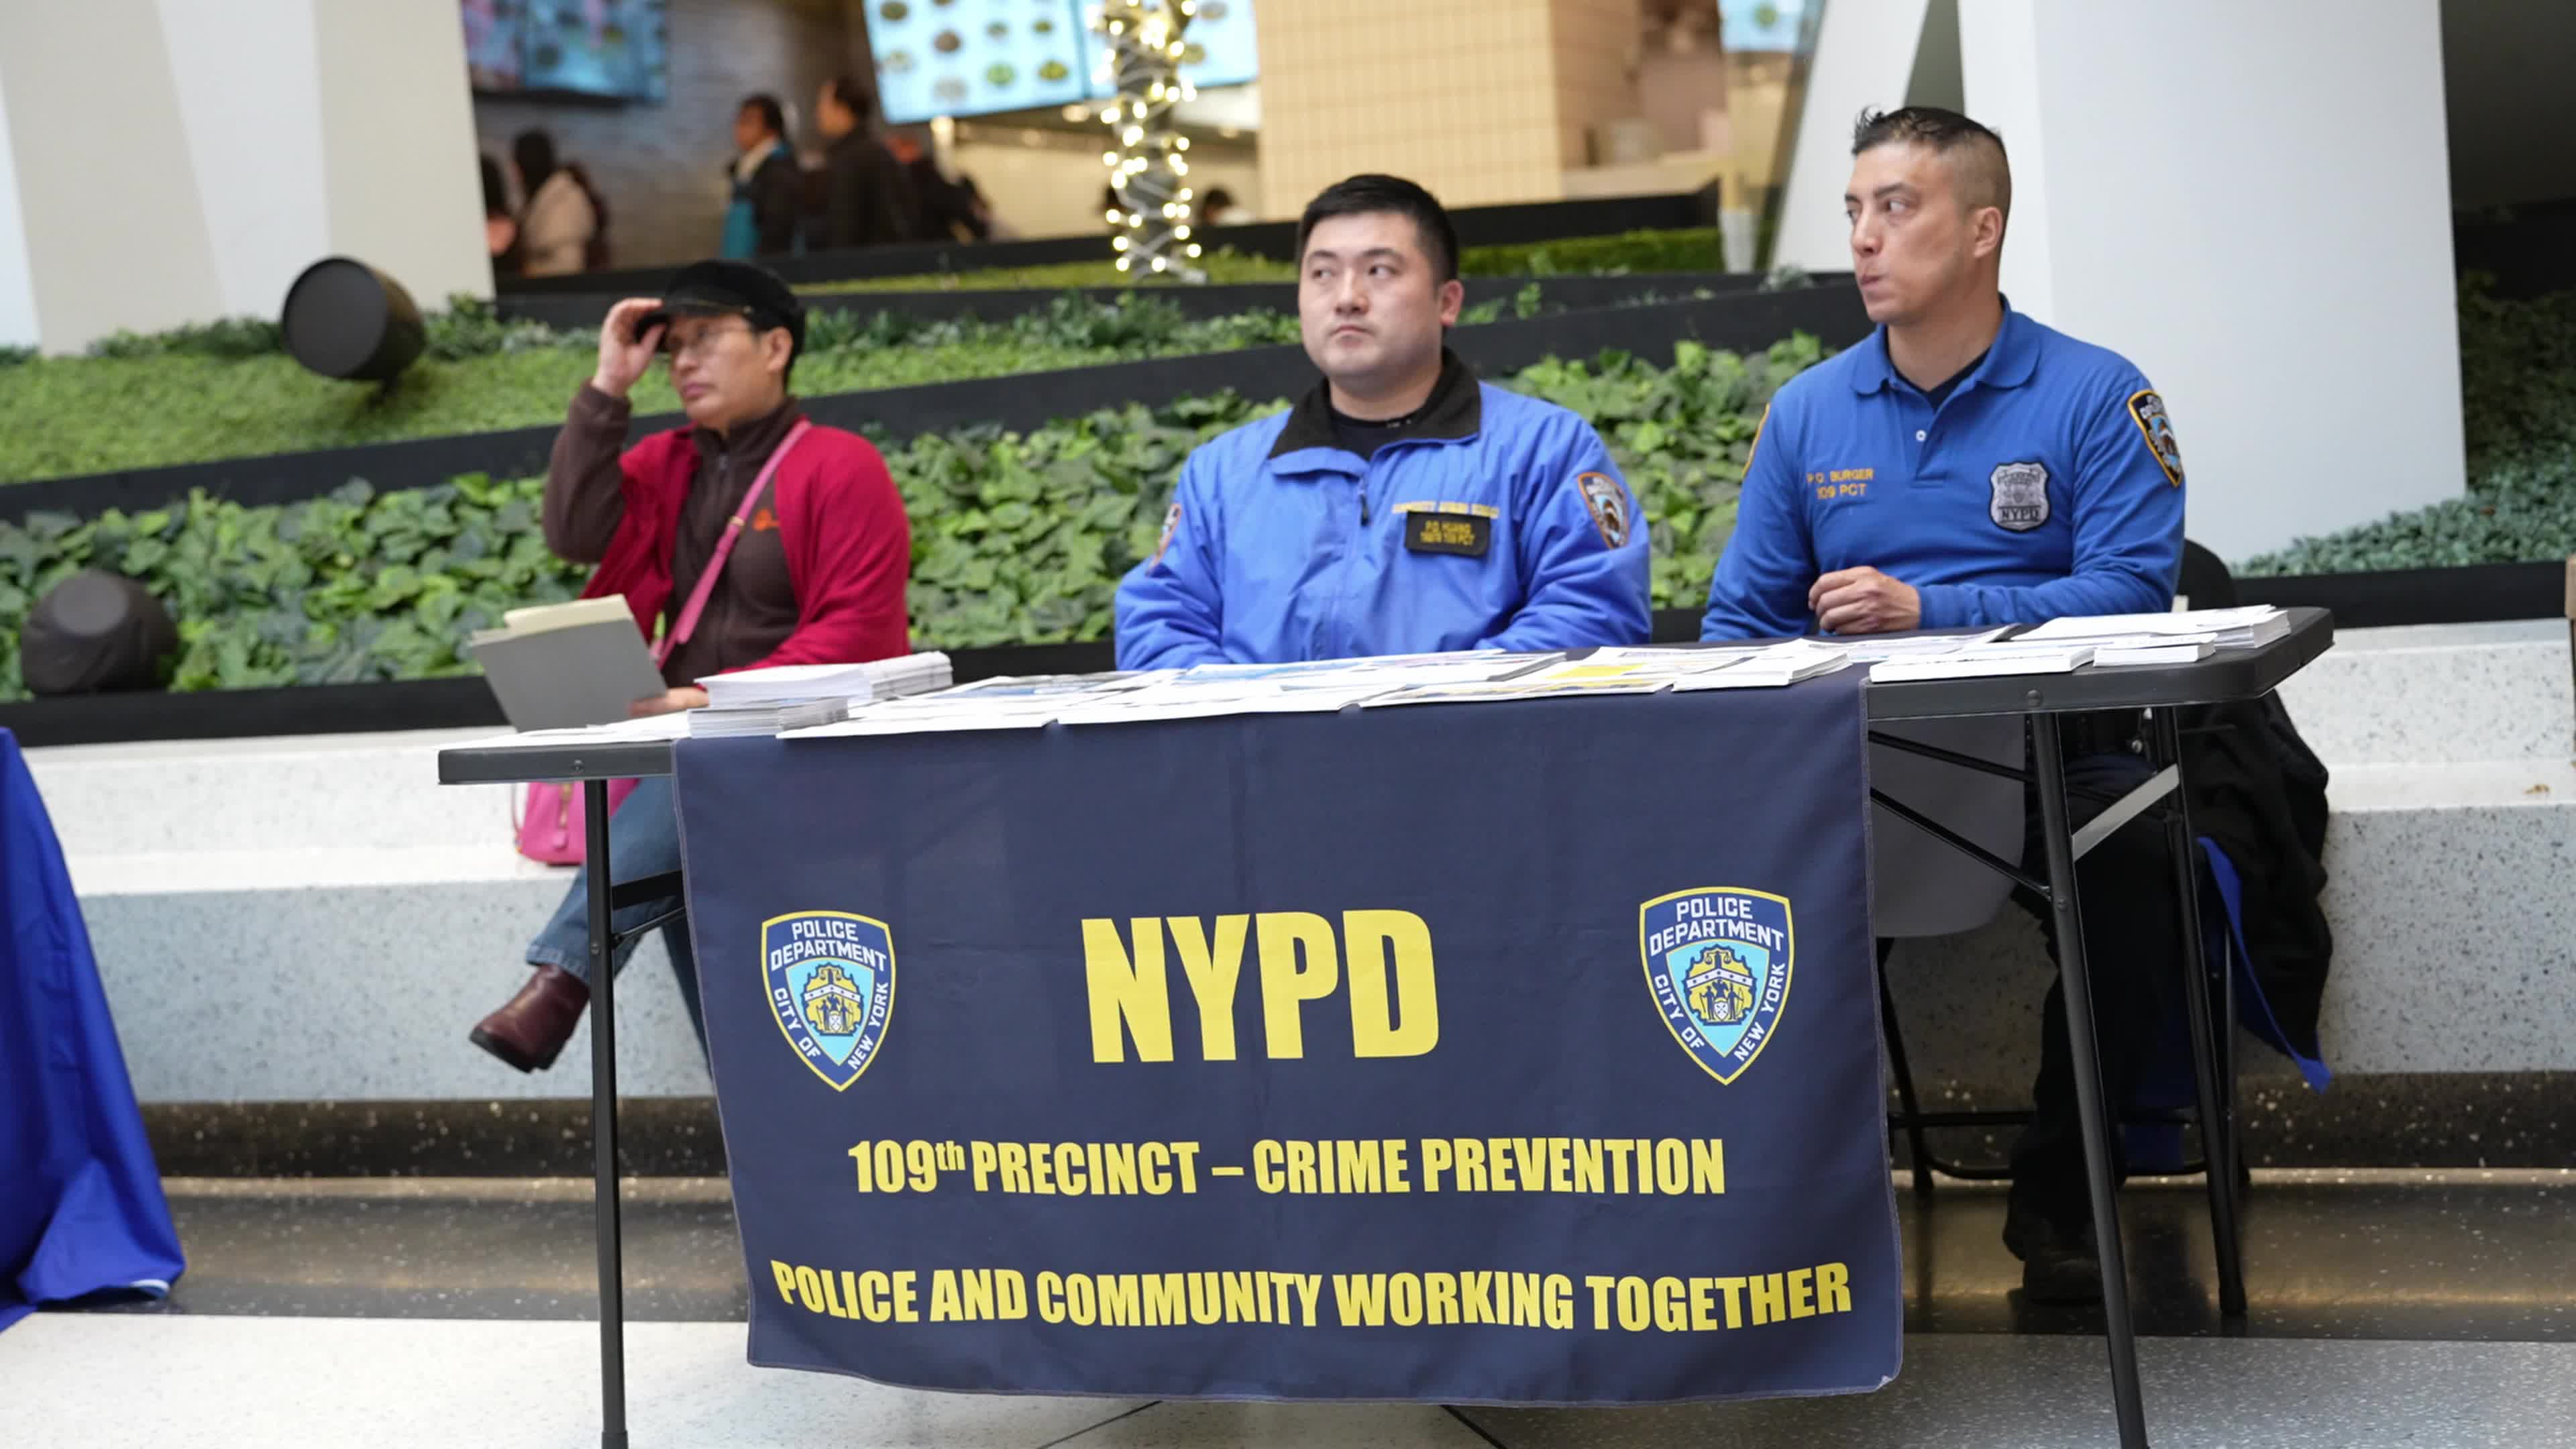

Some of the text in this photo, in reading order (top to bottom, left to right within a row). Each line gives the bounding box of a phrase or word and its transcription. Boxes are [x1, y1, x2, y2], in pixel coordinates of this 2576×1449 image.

[1817, 482, 1868, 499] 109 PCT
[1830, 468, 1873, 482] BURGER
[2000, 508, 2040, 522] NYPD
[1676, 896, 1753, 922] POLICE
[792, 920, 859, 941] POLICE
[1650, 918, 1784, 957] DEPARTMENT
[771, 939, 888, 972] DEPARTMENT
[1081, 909, 1439, 1063] NYPD
[773, 981, 889, 1070] CITY OF NEW YORK
[1654, 963, 1786, 1061] CITY OF NEW YORK
[848, 1140, 966, 1193] 109th
[971, 1140, 1200, 1196] PRECINCT
[1252, 1139, 1411, 1194] CRIME
[1421, 1137, 1725, 1195] PREVENTION
[770, 1259, 1852, 1332] POLICE AND COMMUNITY WORKING TOGETHER
